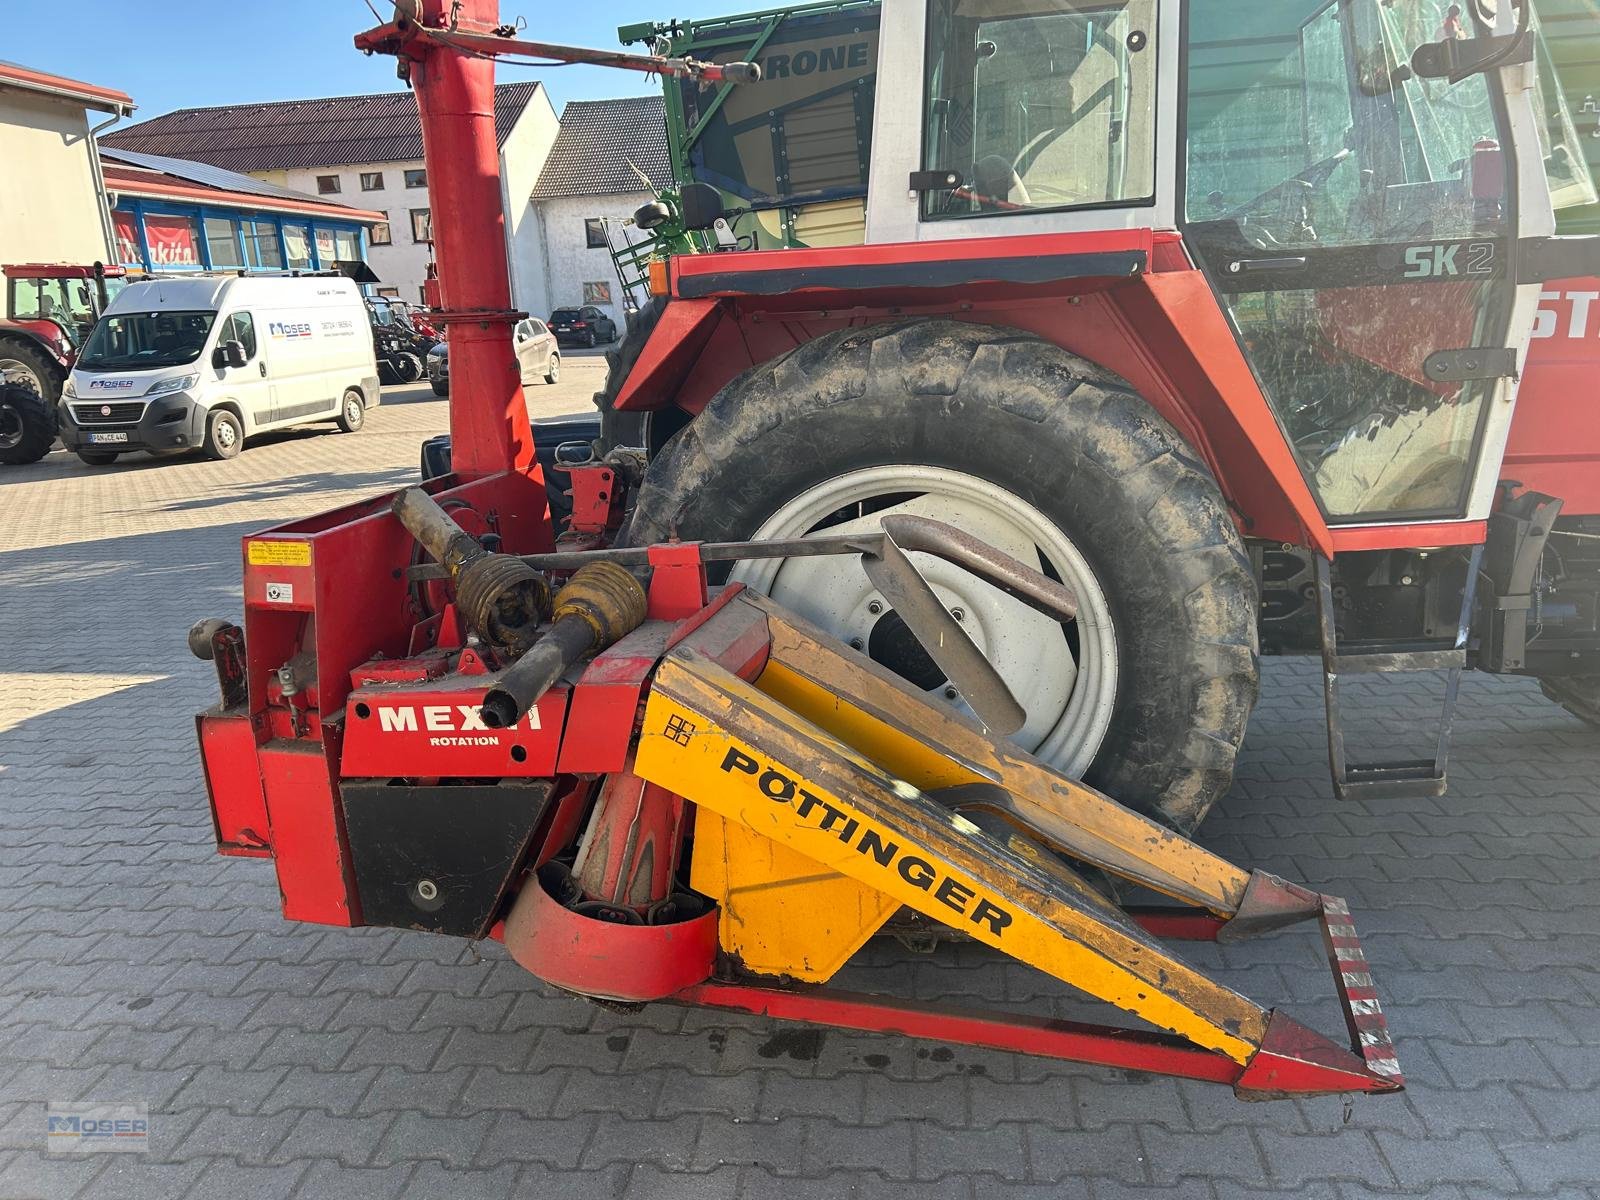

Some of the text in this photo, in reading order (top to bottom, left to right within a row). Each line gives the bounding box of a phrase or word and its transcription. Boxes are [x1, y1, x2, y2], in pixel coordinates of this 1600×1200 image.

[1531, 290, 1600, 339] ST
[269, 322, 312, 335] MOSER
[90, 380, 134, 388] MOSER
[430, 736, 500, 746] ROTATION
[720, 746, 1013, 937] PÖTTINGER
